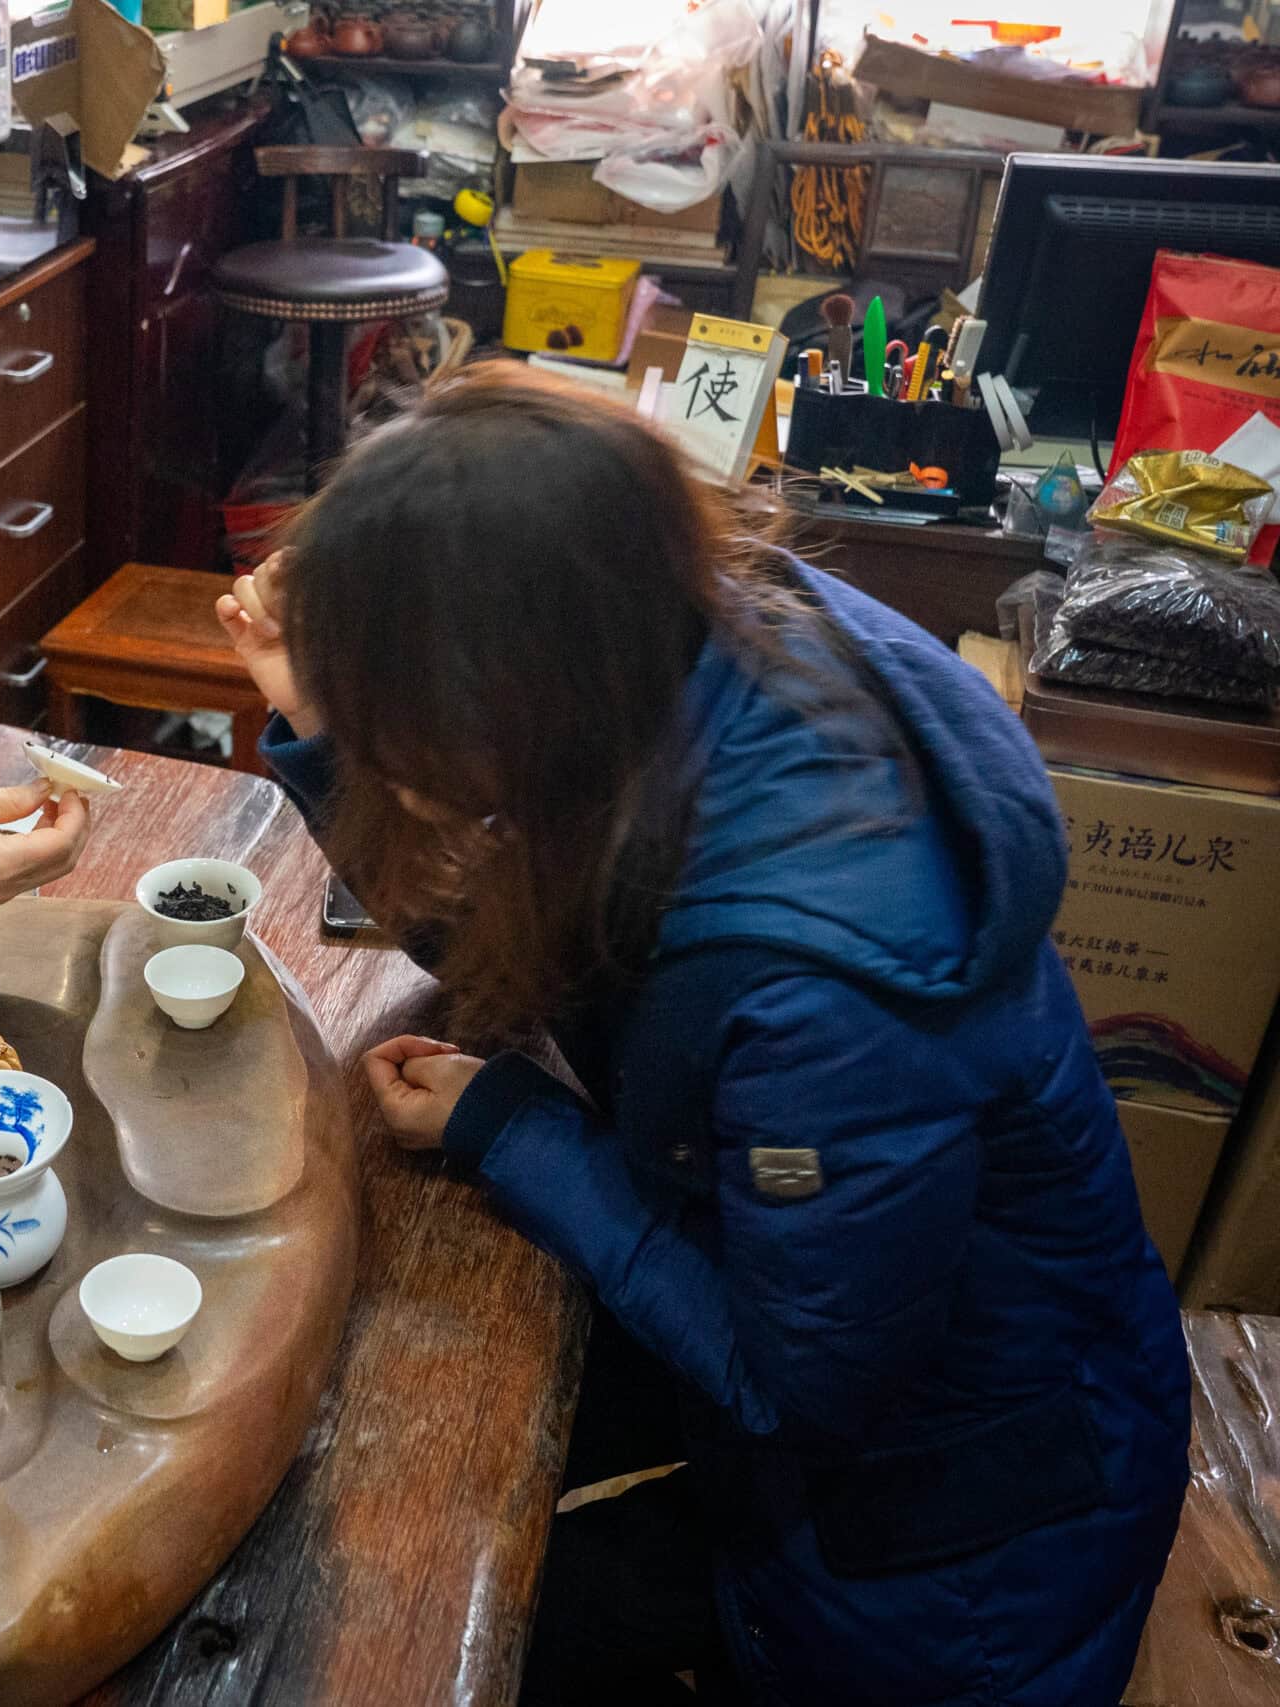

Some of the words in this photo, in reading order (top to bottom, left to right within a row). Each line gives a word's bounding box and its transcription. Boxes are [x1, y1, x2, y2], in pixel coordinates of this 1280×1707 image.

[682, 359, 743, 422] 使
[1066, 816, 1237, 873] 夷语儿泉
